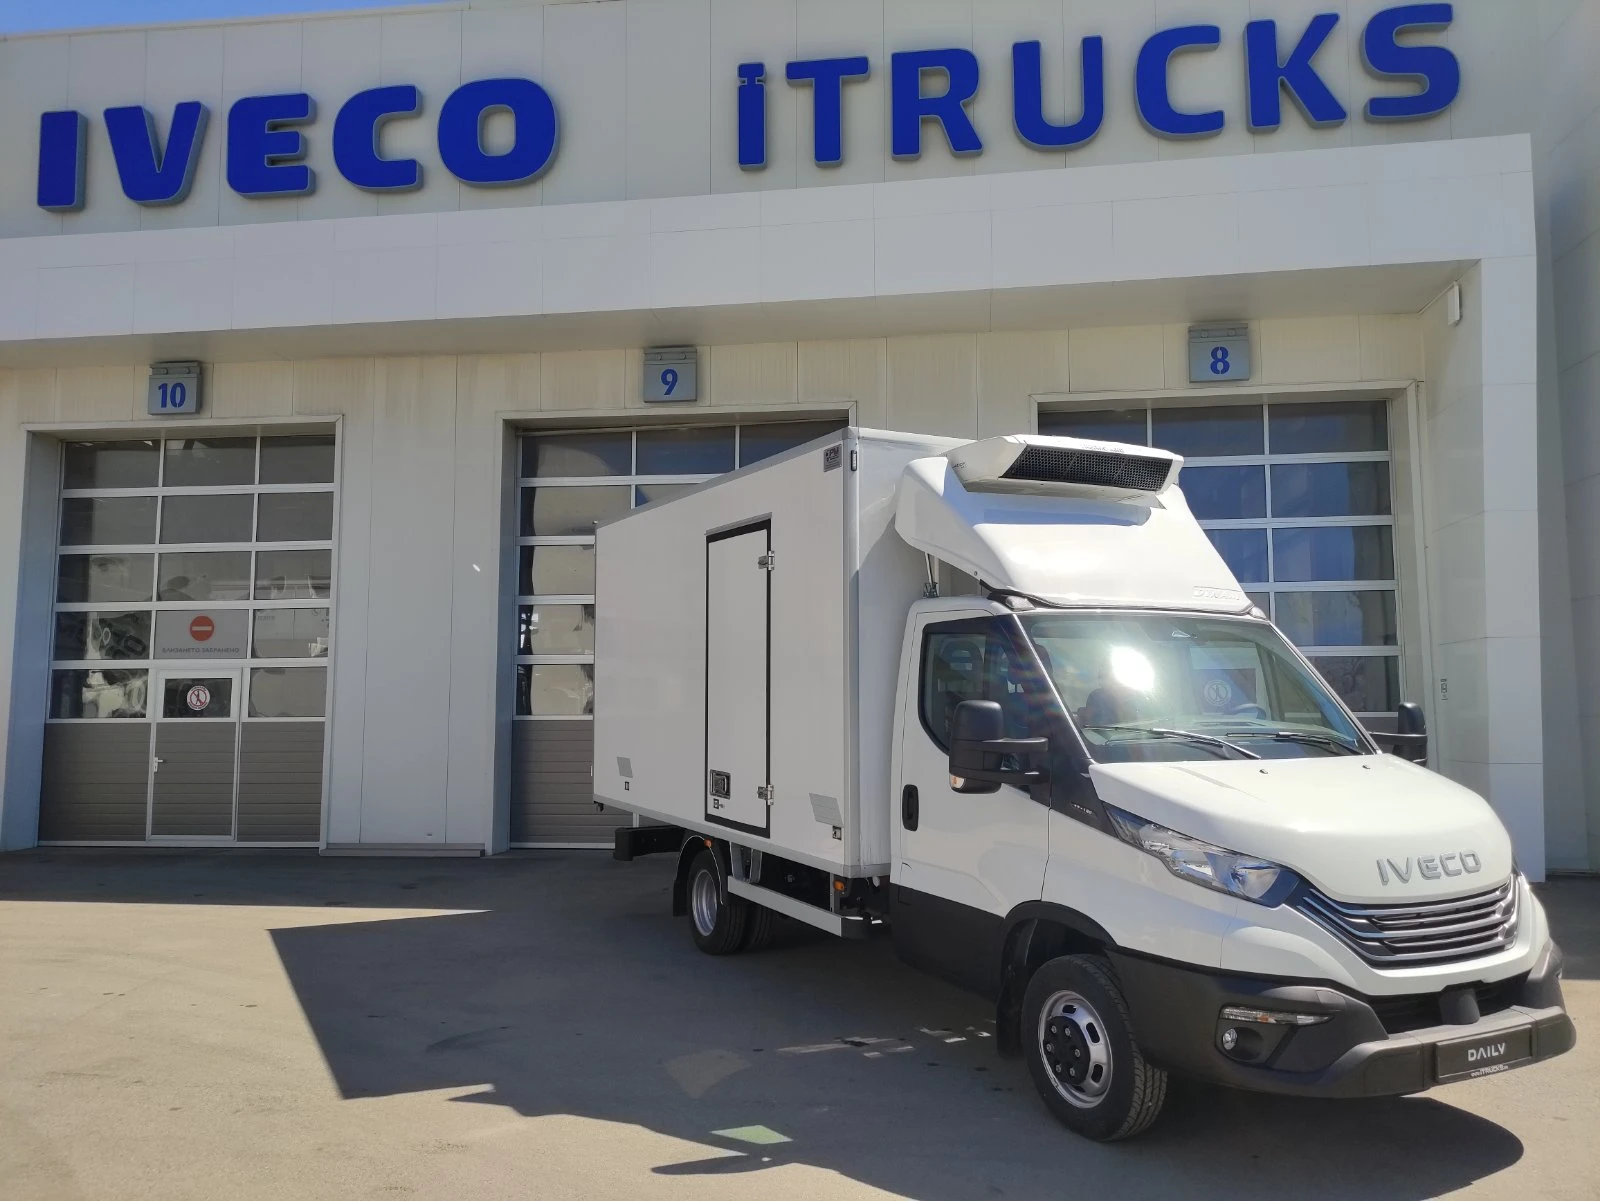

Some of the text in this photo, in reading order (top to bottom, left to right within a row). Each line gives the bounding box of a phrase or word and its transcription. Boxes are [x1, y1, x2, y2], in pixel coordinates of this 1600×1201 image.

[37, 78, 559, 211] IVECO
[1210, 346, 1230, 375] 8
[158, 382, 186, 409] 10
[660, 368, 678, 396] 9
[1376, 849, 1482, 886] IVECO
